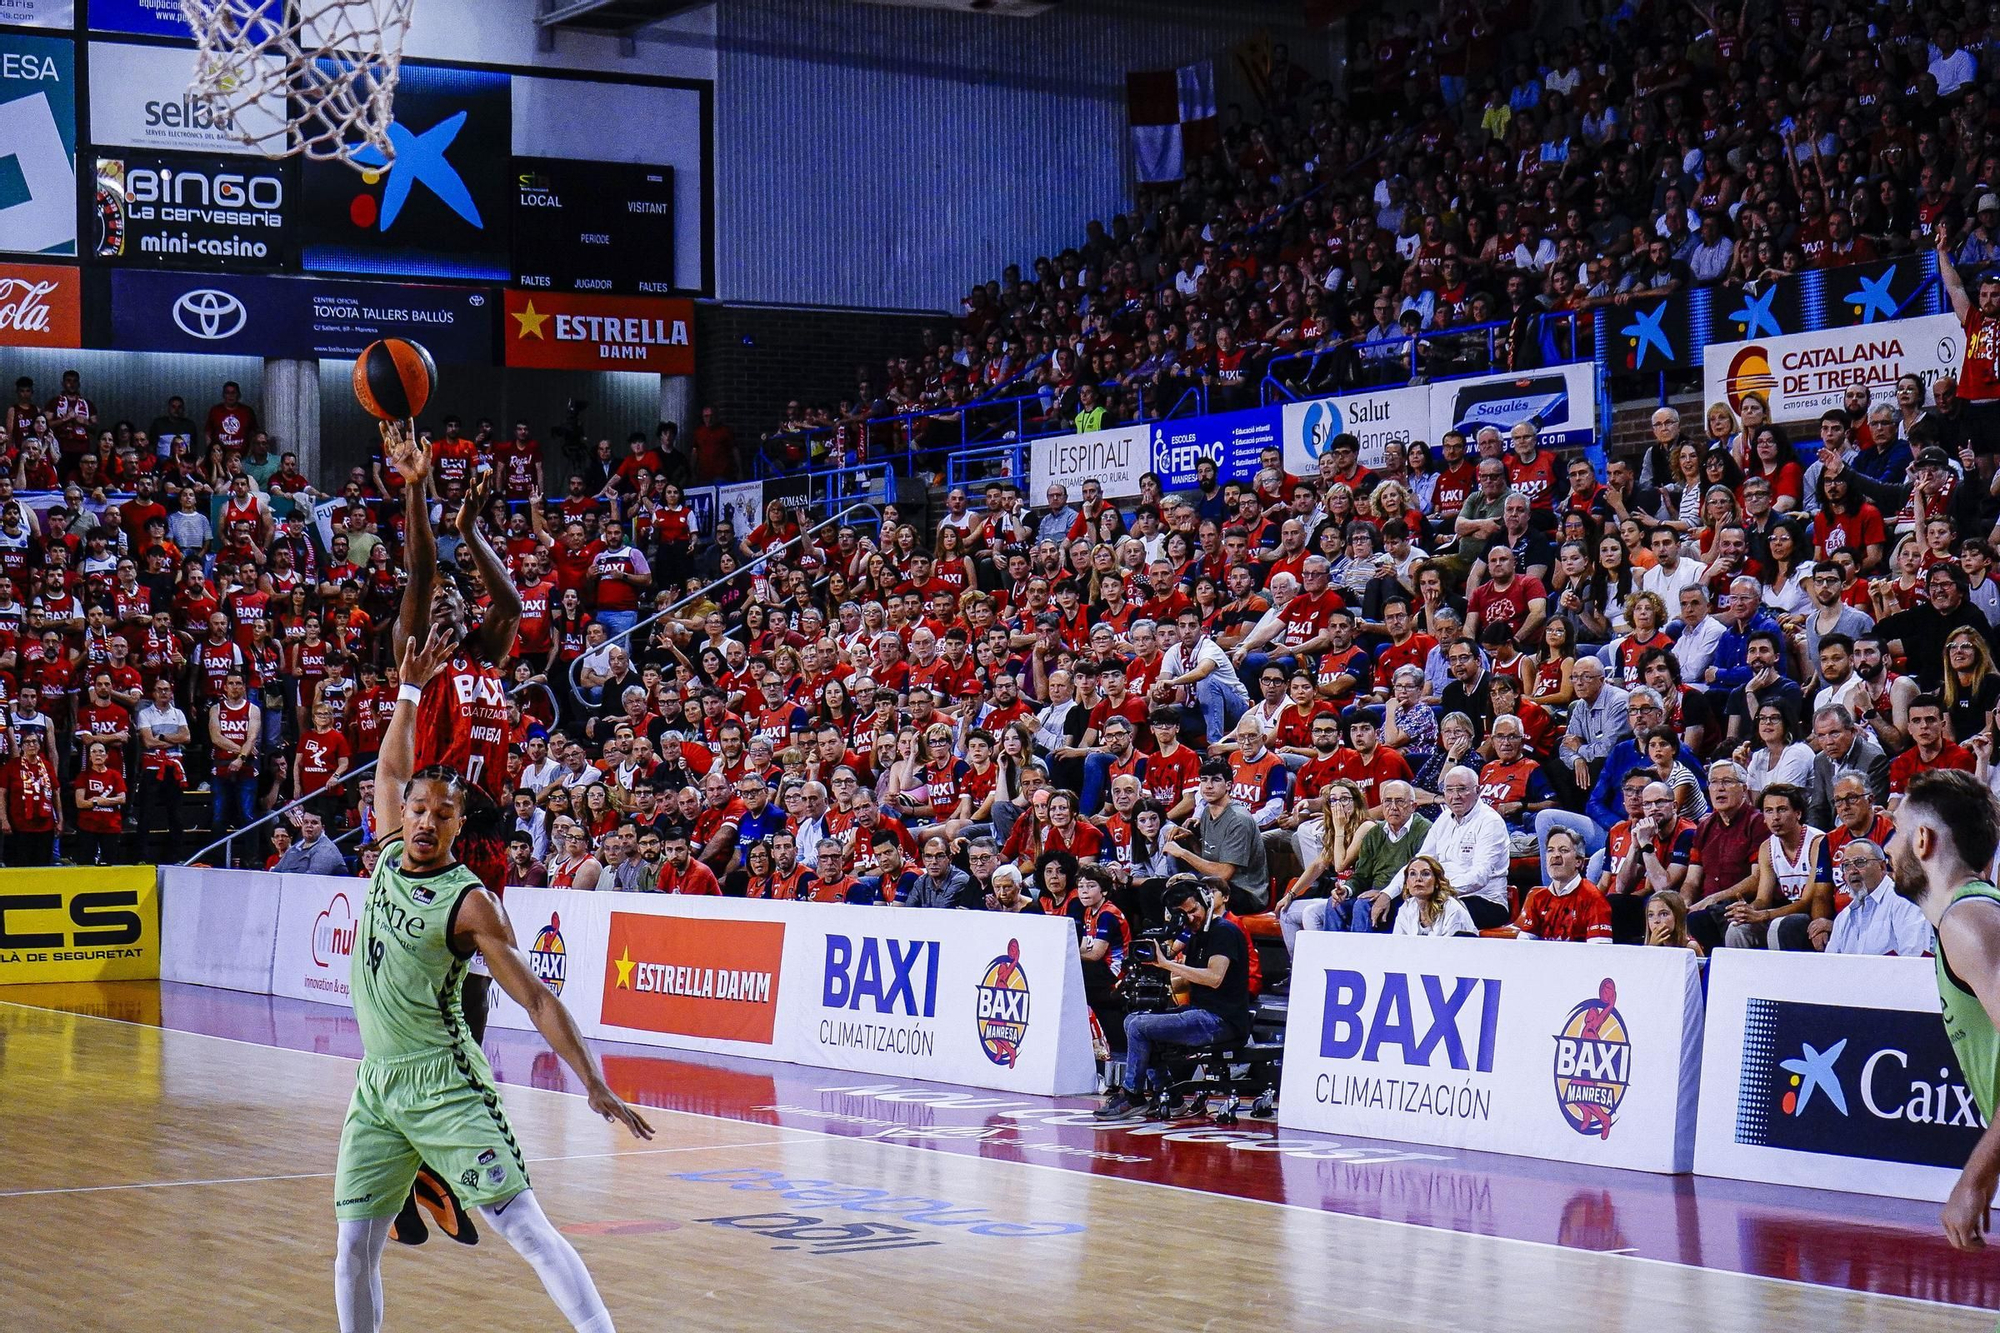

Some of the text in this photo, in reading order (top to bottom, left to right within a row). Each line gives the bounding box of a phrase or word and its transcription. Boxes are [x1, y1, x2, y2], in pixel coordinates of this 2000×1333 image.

[520, 194, 563, 208] LOCAL
[627, 201, 668, 214] VISITANT
[141, 230, 268, 258] mini-casino
[580, 233, 610, 244] PERIODE
[521, 275, 550, 286] FALTES
[574, 279, 613, 289] JUGADOR
[639, 281, 668, 292] FALTES
[0, 278, 59, 331] ola
[313, 305, 455, 323] TOYOTA TALLERS BALLÚS
[556, 314, 689, 346] ESTRELLA
[600, 344, 647, 360] DAMM
[1782, 339, 1905, 371] CATALANA
[1783, 362, 1902, 395] DE TREBALL
[1477, 399, 1529, 415] Sagalés
[1822, 395, 1833, 406] de
[1349, 398, 1390, 425] Salut
[1171, 433, 1196, 445] ESCOLES
[440, 457, 467, 470] BAXI
[1109, 470, 1130, 483] RURAL
[1511, 479, 1548, 495] BAXI
[1440, 489, 1463, 502] BAXI
[4, 554, 24, 564] BAXI
[721, 590, 740, 604] GAP
[45, 610, 74, 622] BAXI
[236, 607, 264, 620] BAXI
[0, 621, 19, 632] AXI
[285, 626, 306, 637] BAX
[1287, 621, 1313, 636] BAXI
[203, 656, 232, 669] BAXI
[302, 655, 325, 667] BAXI
[379, 701, 397, 712] BAX
[91, 721, 117, 734] BAX
[220, 719, 249, 732] BAXI
[927, 782, 955, 797] BAXI
[1229, 784, 1261, 801] AXI
[1479, 783, 1511, 801] AXI
[27, 953, 48, 963] DE
[53, 948, 144, 962] SEGURETAT
[531, 952, 566, 979] BAXI
[304, 974, 334, 992] innovation
[634, 961, 772, 1003] ESTRELLA DAMM
[821, 933, 941, 1018] BAXI
[978, 988, 1030, 1024] BAXI
[1319, 968, 1502, 1073] BAXI
[819, 1018, 934, 1058] CLIMATIZACIÓN
[984, 1023, 1020, 1043] MANRESA
[1556, 1038, 1630, 1084] BAXI
[1566, 1082, 1616, 1108] MANRESA
[1860, 1048, 1986, 1129] Caix
[1315, 1073, 1491, 1121] CLIMATIZACIÓN
[814, 1084, 1458, 1167] NOU CONGOST
[668, 1168, 1088, 1237] endesa
[693, 1212, 944, 1255] liga
